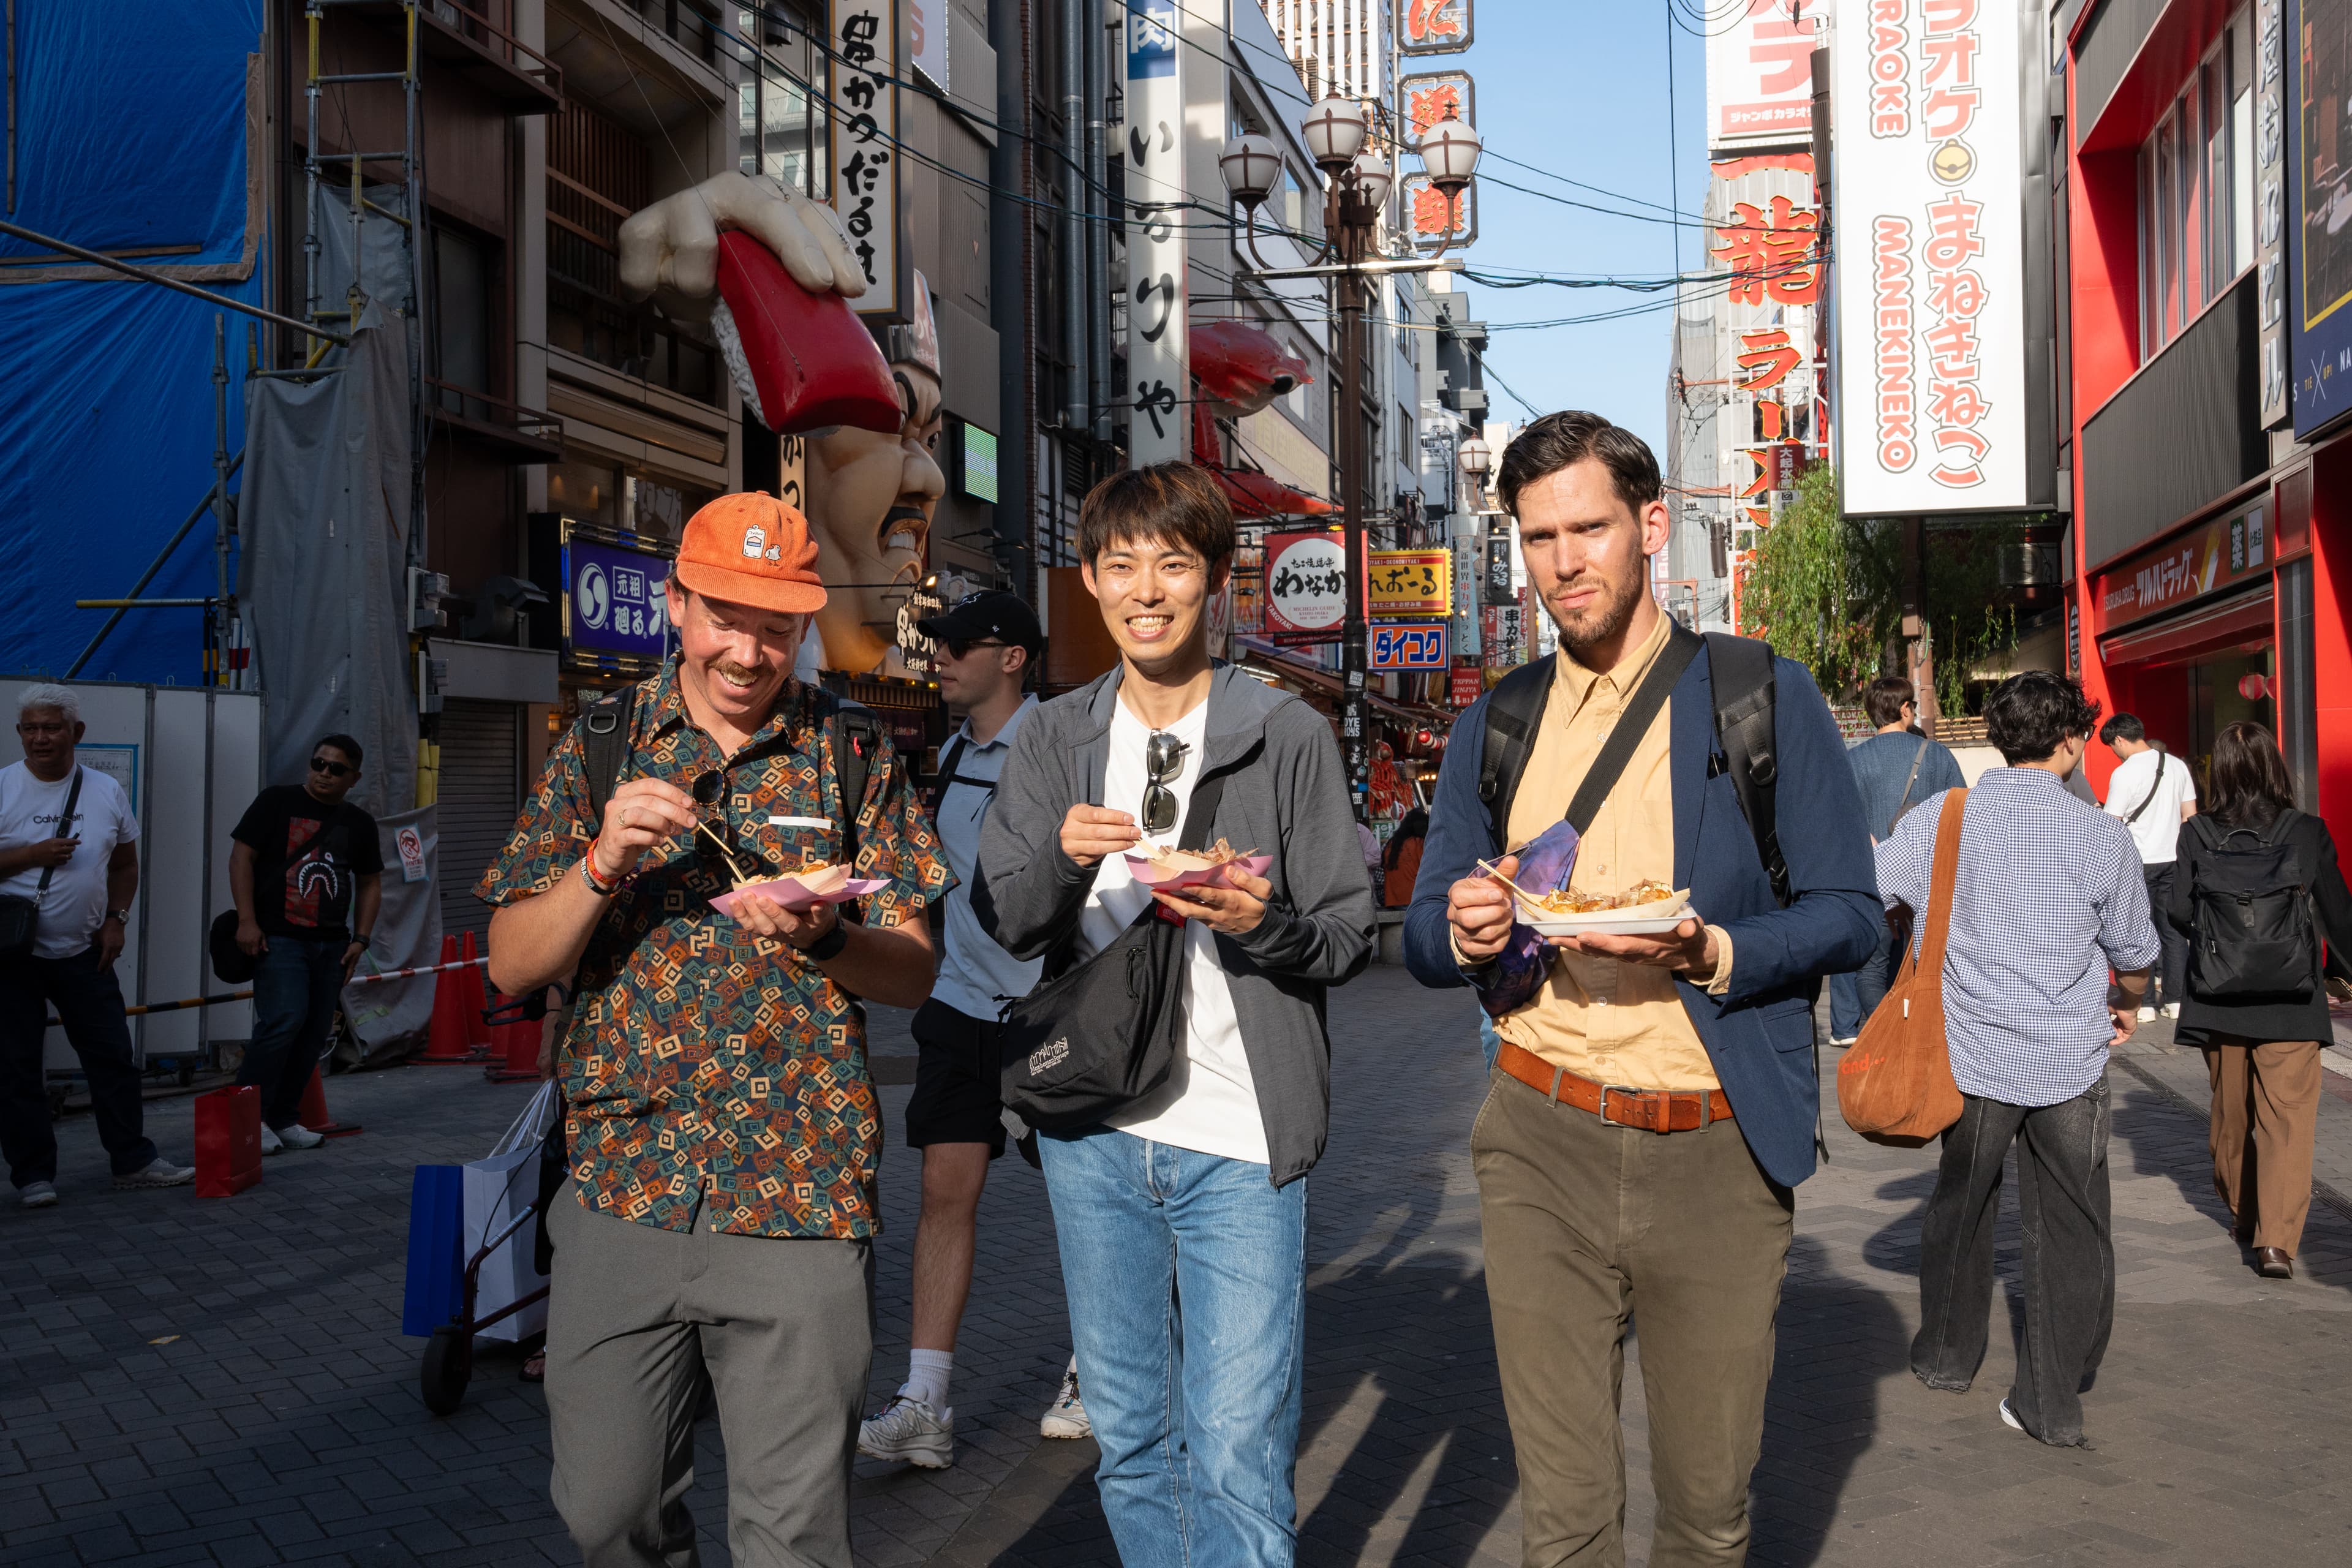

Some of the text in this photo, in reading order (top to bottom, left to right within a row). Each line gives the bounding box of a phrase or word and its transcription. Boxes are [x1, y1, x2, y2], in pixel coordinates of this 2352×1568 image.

[1130, 8, 1174, 53] 肉
[1747, 0, 1822, 95] ラ
[1730, 107, 1812, 123] ジャンボカラオ
[2258, 0, 2282, 413] だおれビル
[1130, 121, 1176, 439] いろりや
[1877, 220, 1912, 469] MANEKINEKO
[1926, 195, 1986, 484] まねきねこ
[617, 574, 641, 598] 元祖
[1272, 567, 1346, 598] わなか
[2103, 584, 2135, 612] TSURUHA DRUG
[2136, 548, 2193, 609] ツルハドラッグ
[614, 606, 644, 636] 廻る
[1267, 603, 1293, 630] TAKOYAKI
[1375, 629, 1442, 665] ダイコク
